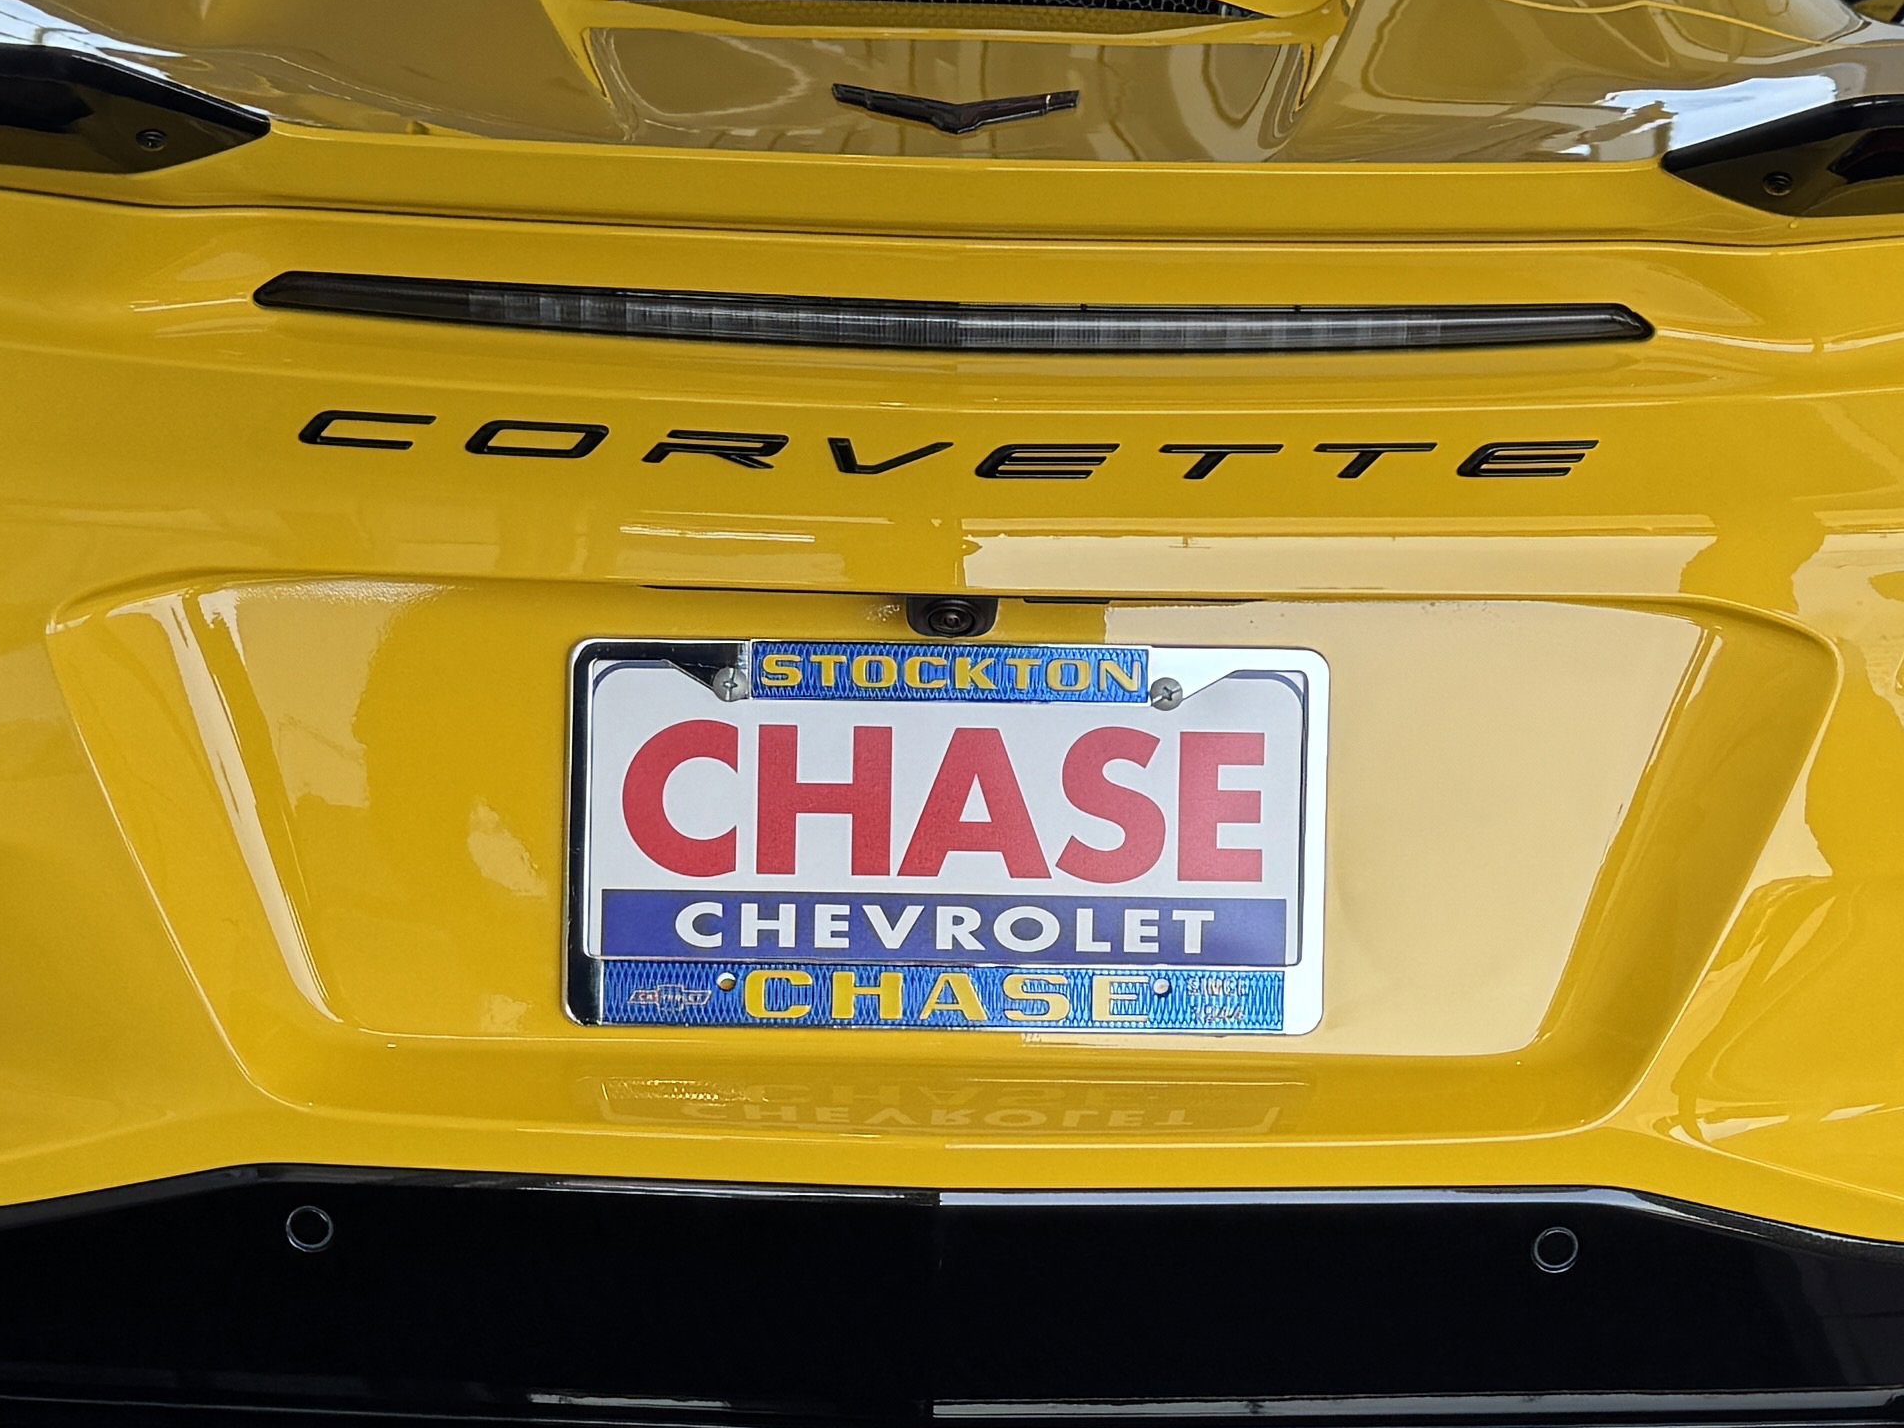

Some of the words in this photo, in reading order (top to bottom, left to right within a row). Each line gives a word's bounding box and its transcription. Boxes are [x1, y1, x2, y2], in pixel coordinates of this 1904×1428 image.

[296, 409, 1601, 482] CORVETTE
[760, 654, 1142, 693] STOCKTON
[621, 718, 1266, 884] CHASE
[674, 901, 1215, 954] CHEVROLET
[745, 969, 1149, 1022] CHASE
